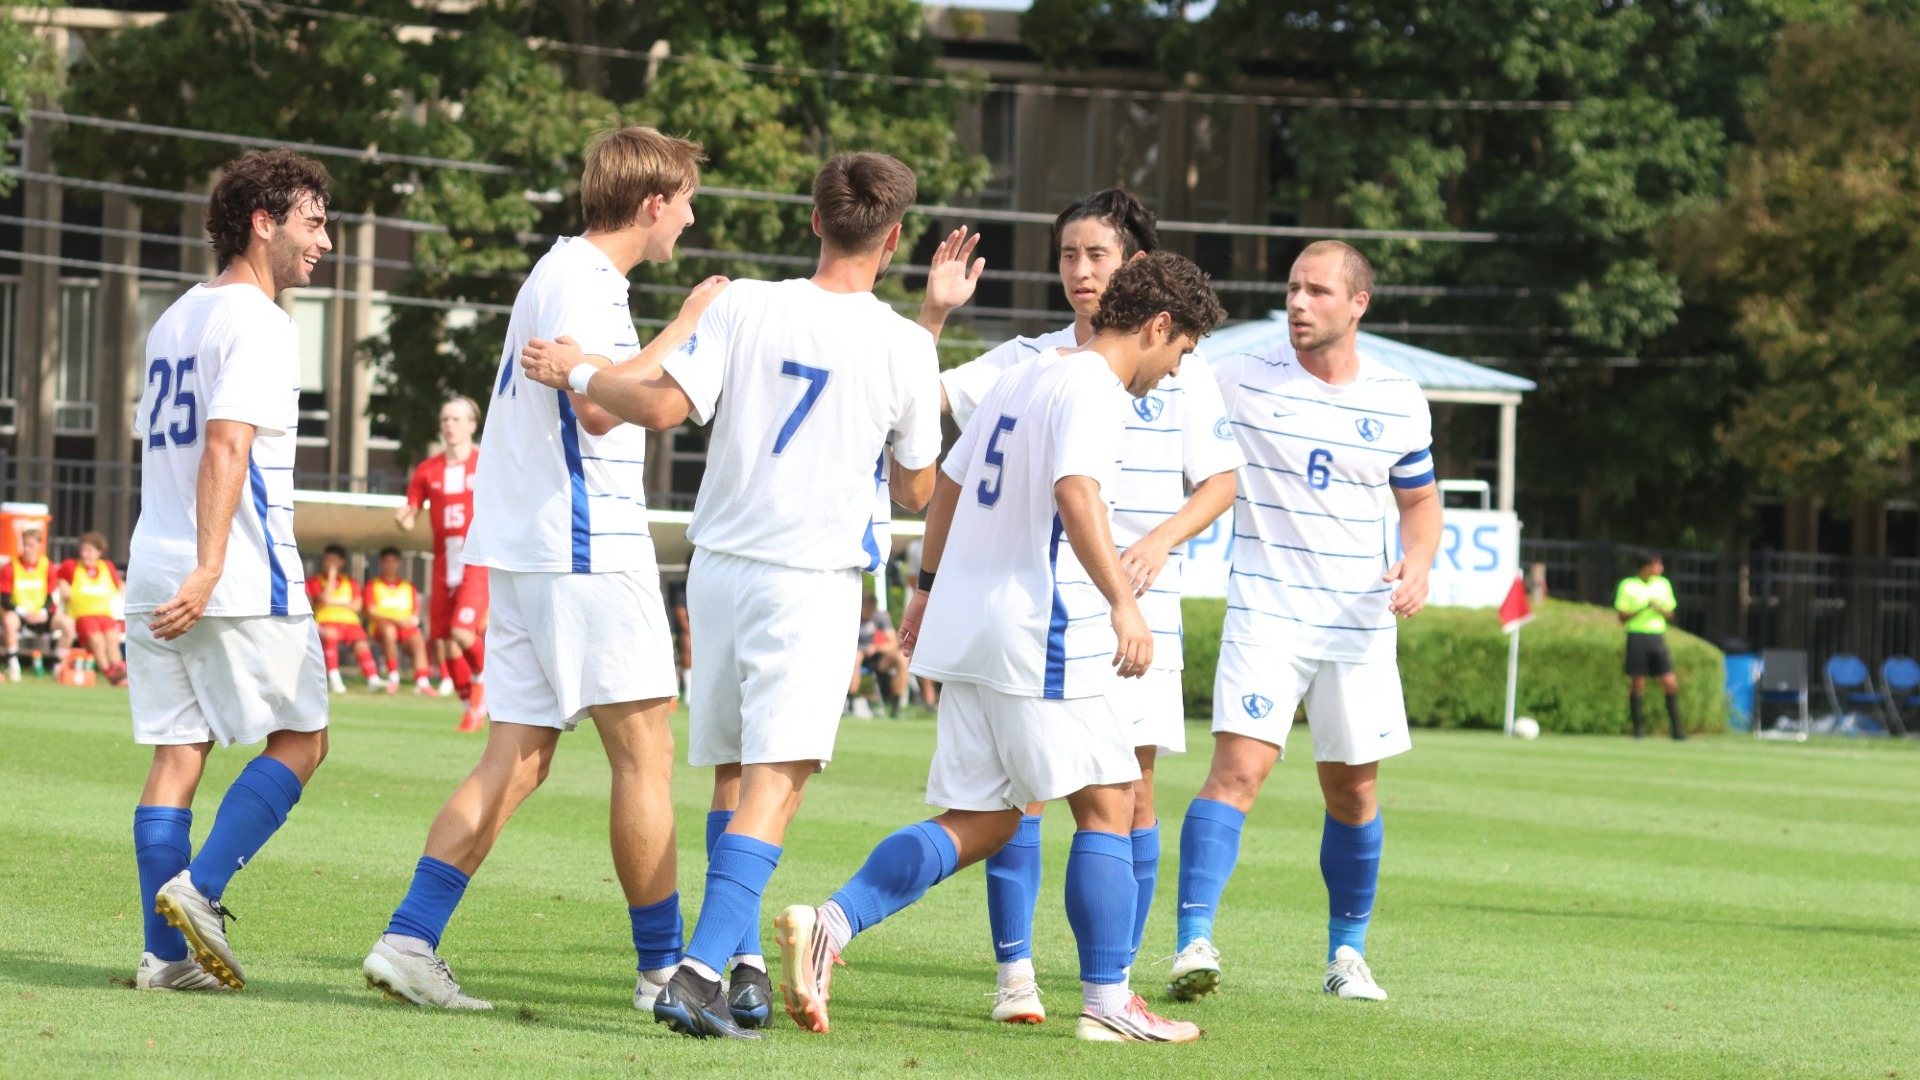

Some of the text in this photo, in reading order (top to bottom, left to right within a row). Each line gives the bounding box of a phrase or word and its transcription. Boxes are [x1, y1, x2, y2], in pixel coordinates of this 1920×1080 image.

[147, 354, 198, 452] 25
[770, 358, 834, 459] 7
[976, 412, 1018, 510] 5
[1307, 448, 1333, 490] 6
[443, 503, 466, 529] 15
